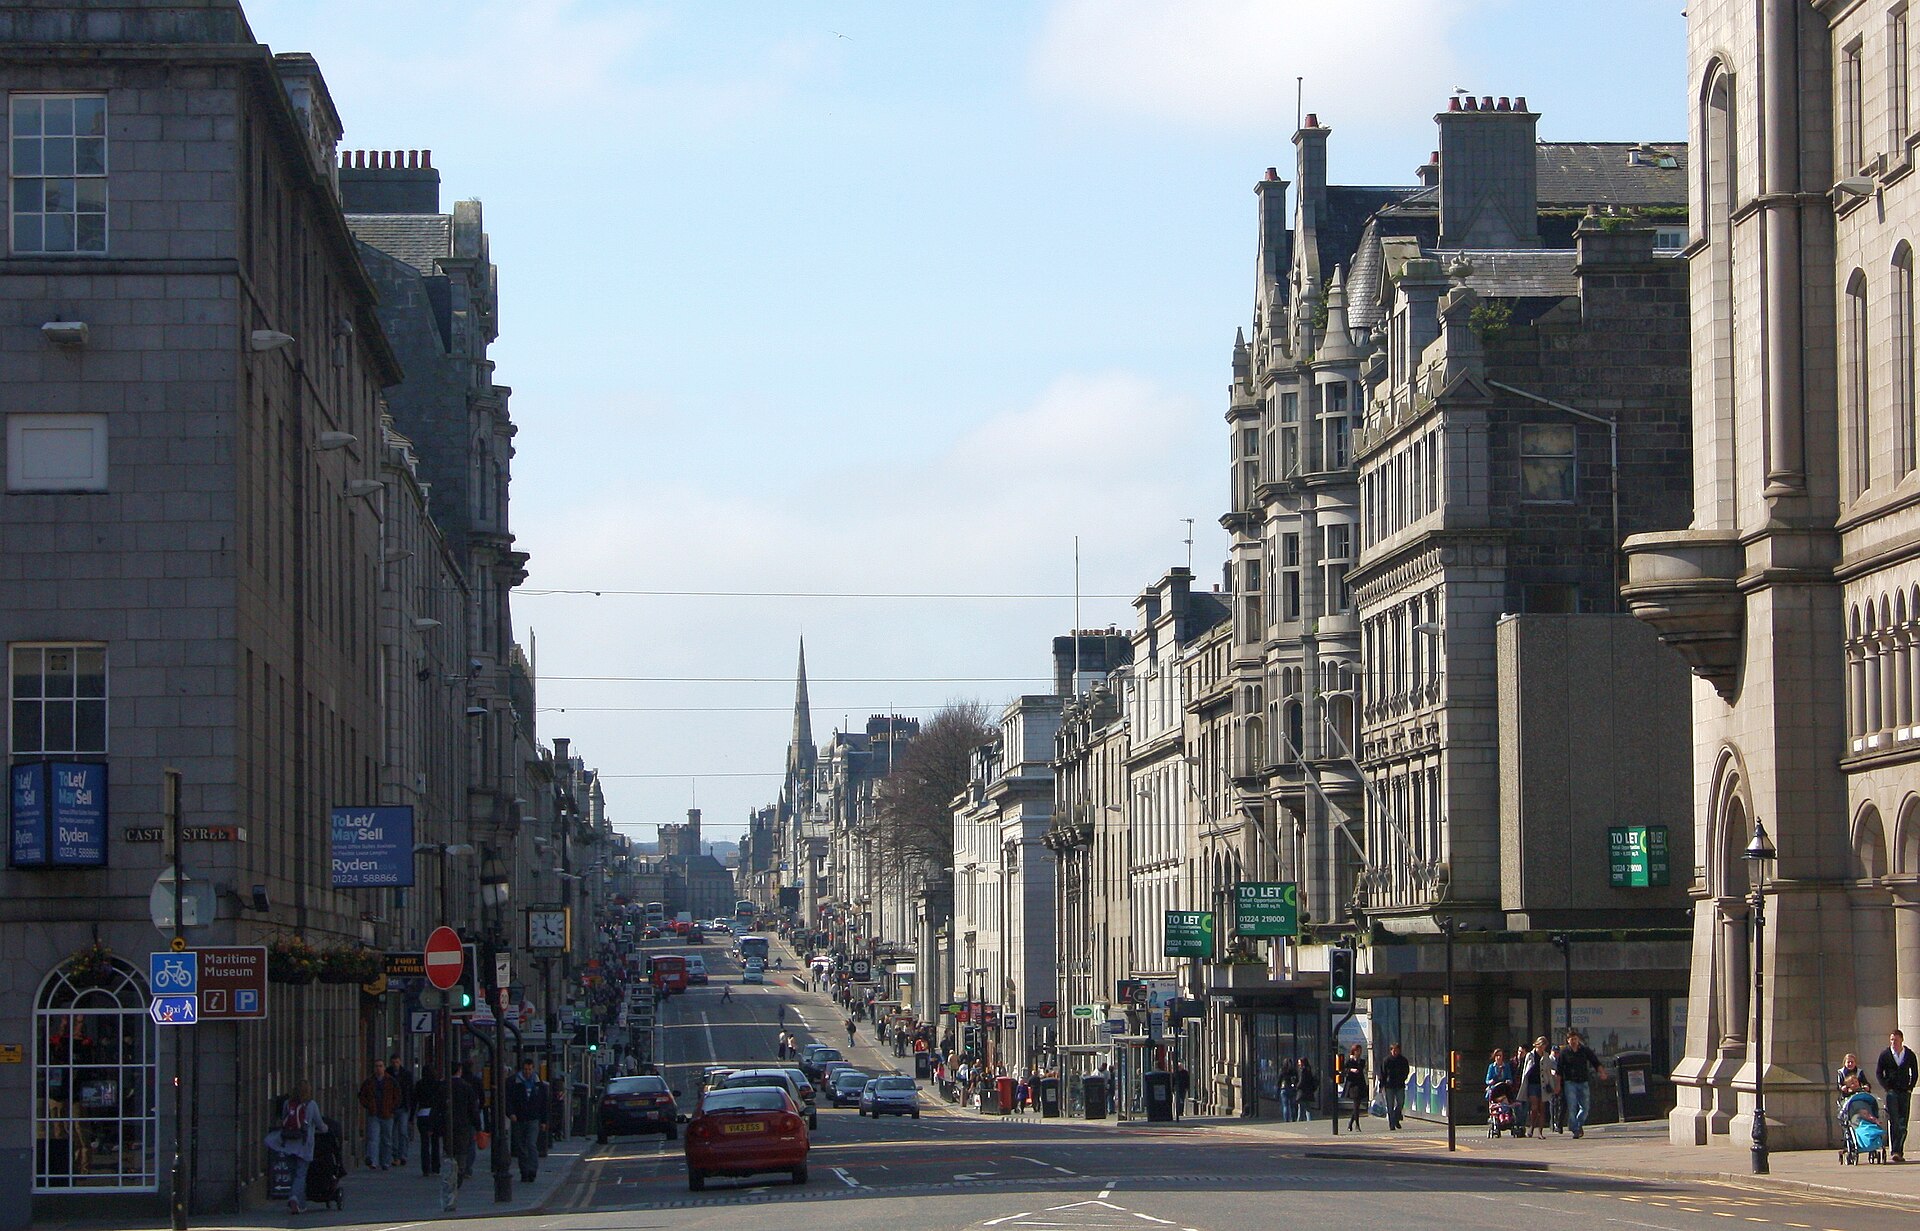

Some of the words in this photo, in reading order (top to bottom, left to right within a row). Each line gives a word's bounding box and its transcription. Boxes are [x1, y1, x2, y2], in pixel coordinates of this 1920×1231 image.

[332, 813, 375, 828] ToLet/
[60, 827, 88, 845] Ryden
[126, 829, 165, 841] CAST
[182, 828, 227, 840] STREE
[332, 828, 383, 843] MaySell
[1611, 832, 1623, 844] TO
[1625, 832, 1638, 844] LET
[332, 874, 358, 883] 01224
[1240, 886, 1256, 898] TO
[1261, 887, 1281, 898] LET
[1168, 915, 1180, 925] TO
[1183, 915, 1200, 925] LET
[205, 954, 256, 964] Maritime
[205, 967, 253, 977] Museum
[165, 1005, 181, 1015] Taxi
